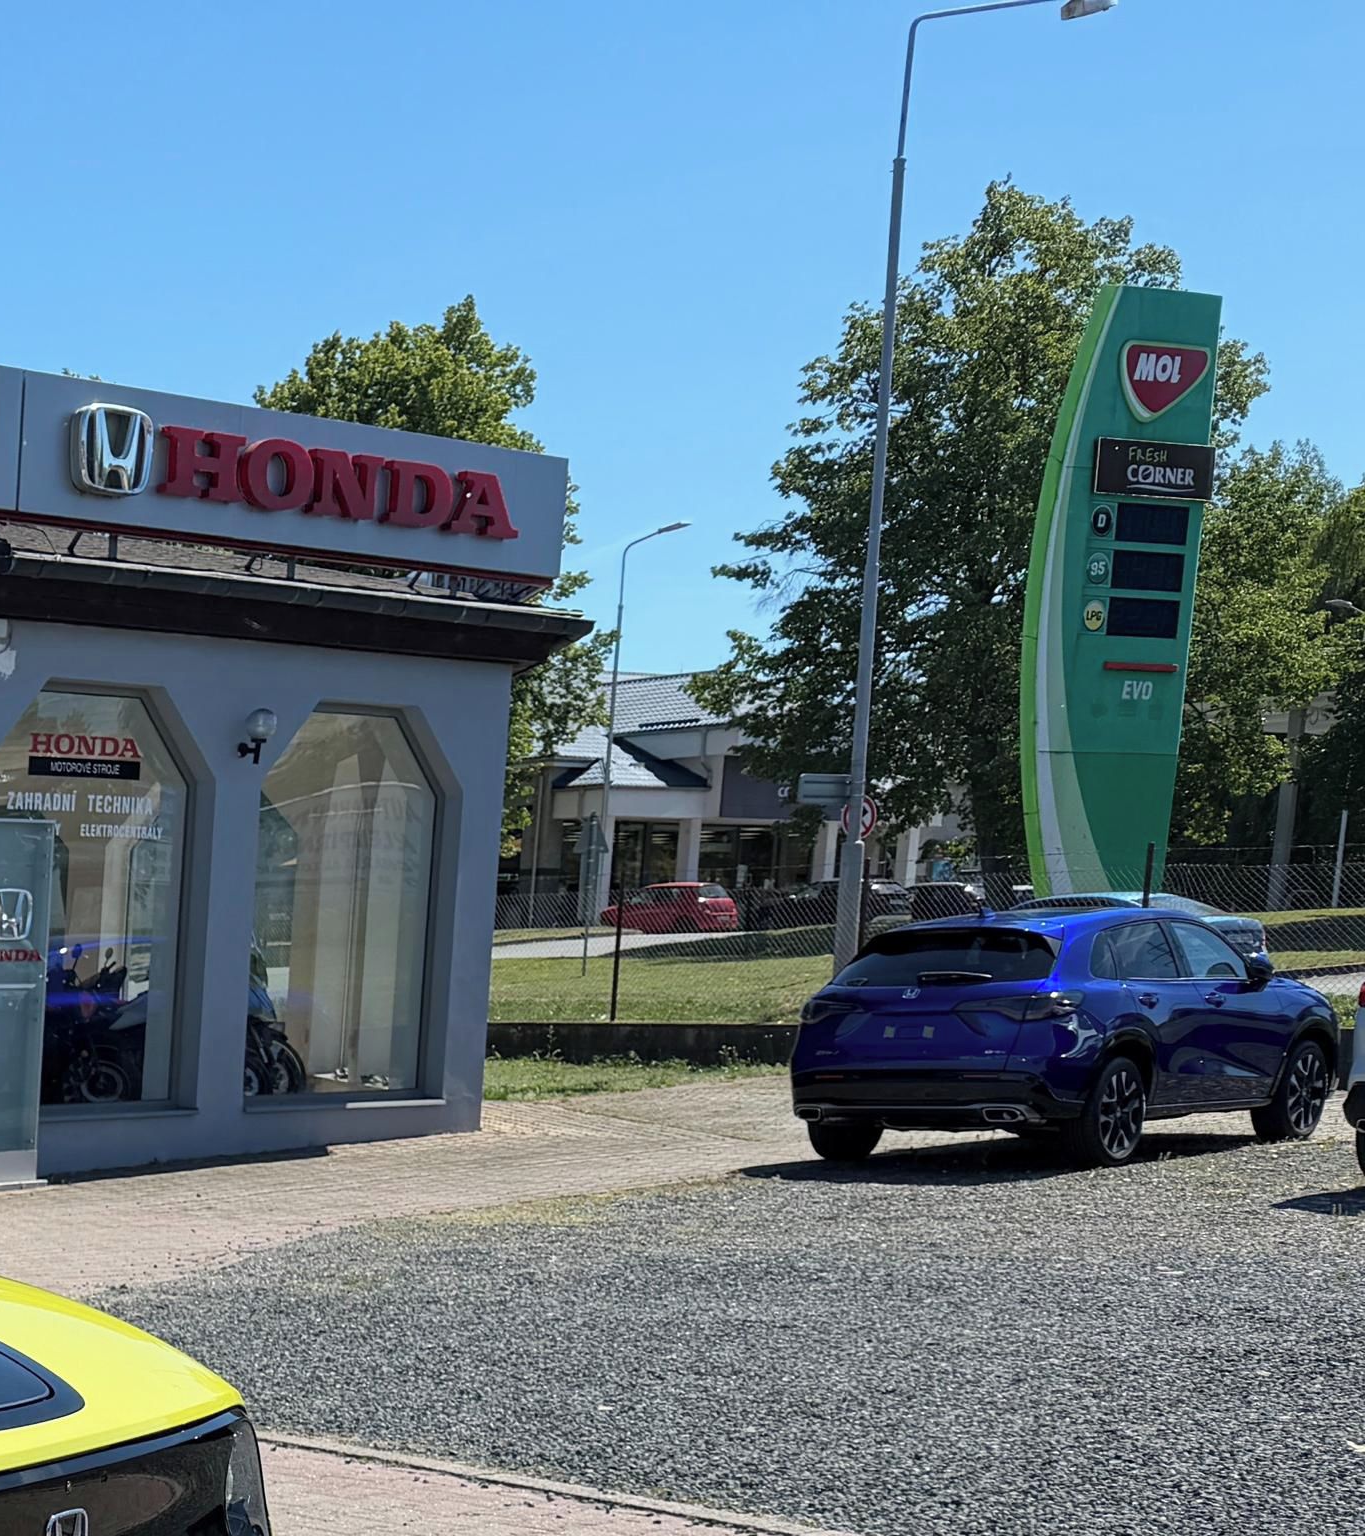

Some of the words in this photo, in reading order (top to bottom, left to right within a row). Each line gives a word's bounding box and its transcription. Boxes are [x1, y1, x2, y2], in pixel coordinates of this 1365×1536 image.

[1133, 352, 1182, 384] MOL
[156, 424, 519, 540] HONDA
[1126, 464, 1195, 486] CORNER
[1097, 515, 1107, 528] D
[1089, 561, 1106, 577] 95
[1085, 610, 1102, 622] LPG
[1121, 680, 1153, 700] EVO
[28, 732, 142, 759] HONDA
[50, 761, 91, 774] MOTOROVÉ
[92, 763, 121, 776] STROJE
[6, 789, 78, 813] ZAHRADNÍ
[87, 794, 153, 816] TECHNIKA
